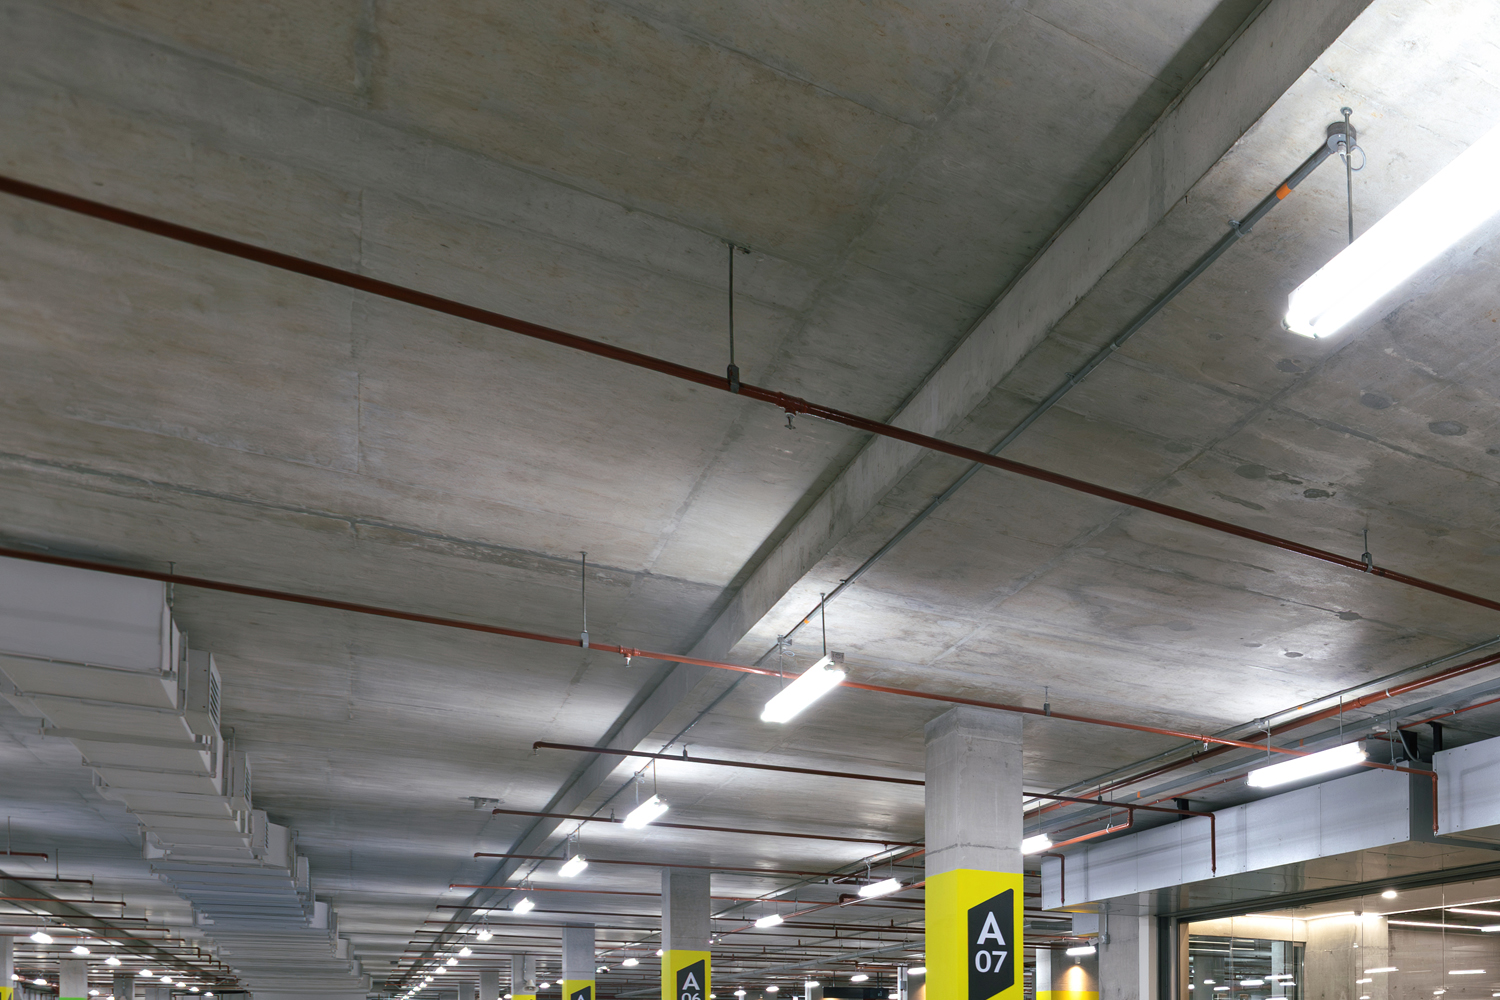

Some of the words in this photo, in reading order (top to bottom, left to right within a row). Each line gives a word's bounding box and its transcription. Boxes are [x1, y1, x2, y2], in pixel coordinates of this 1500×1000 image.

[976, 911, 1006, 946] A
[974, 949, 1008, 973] 07
[682, 971, 701, 991] A
